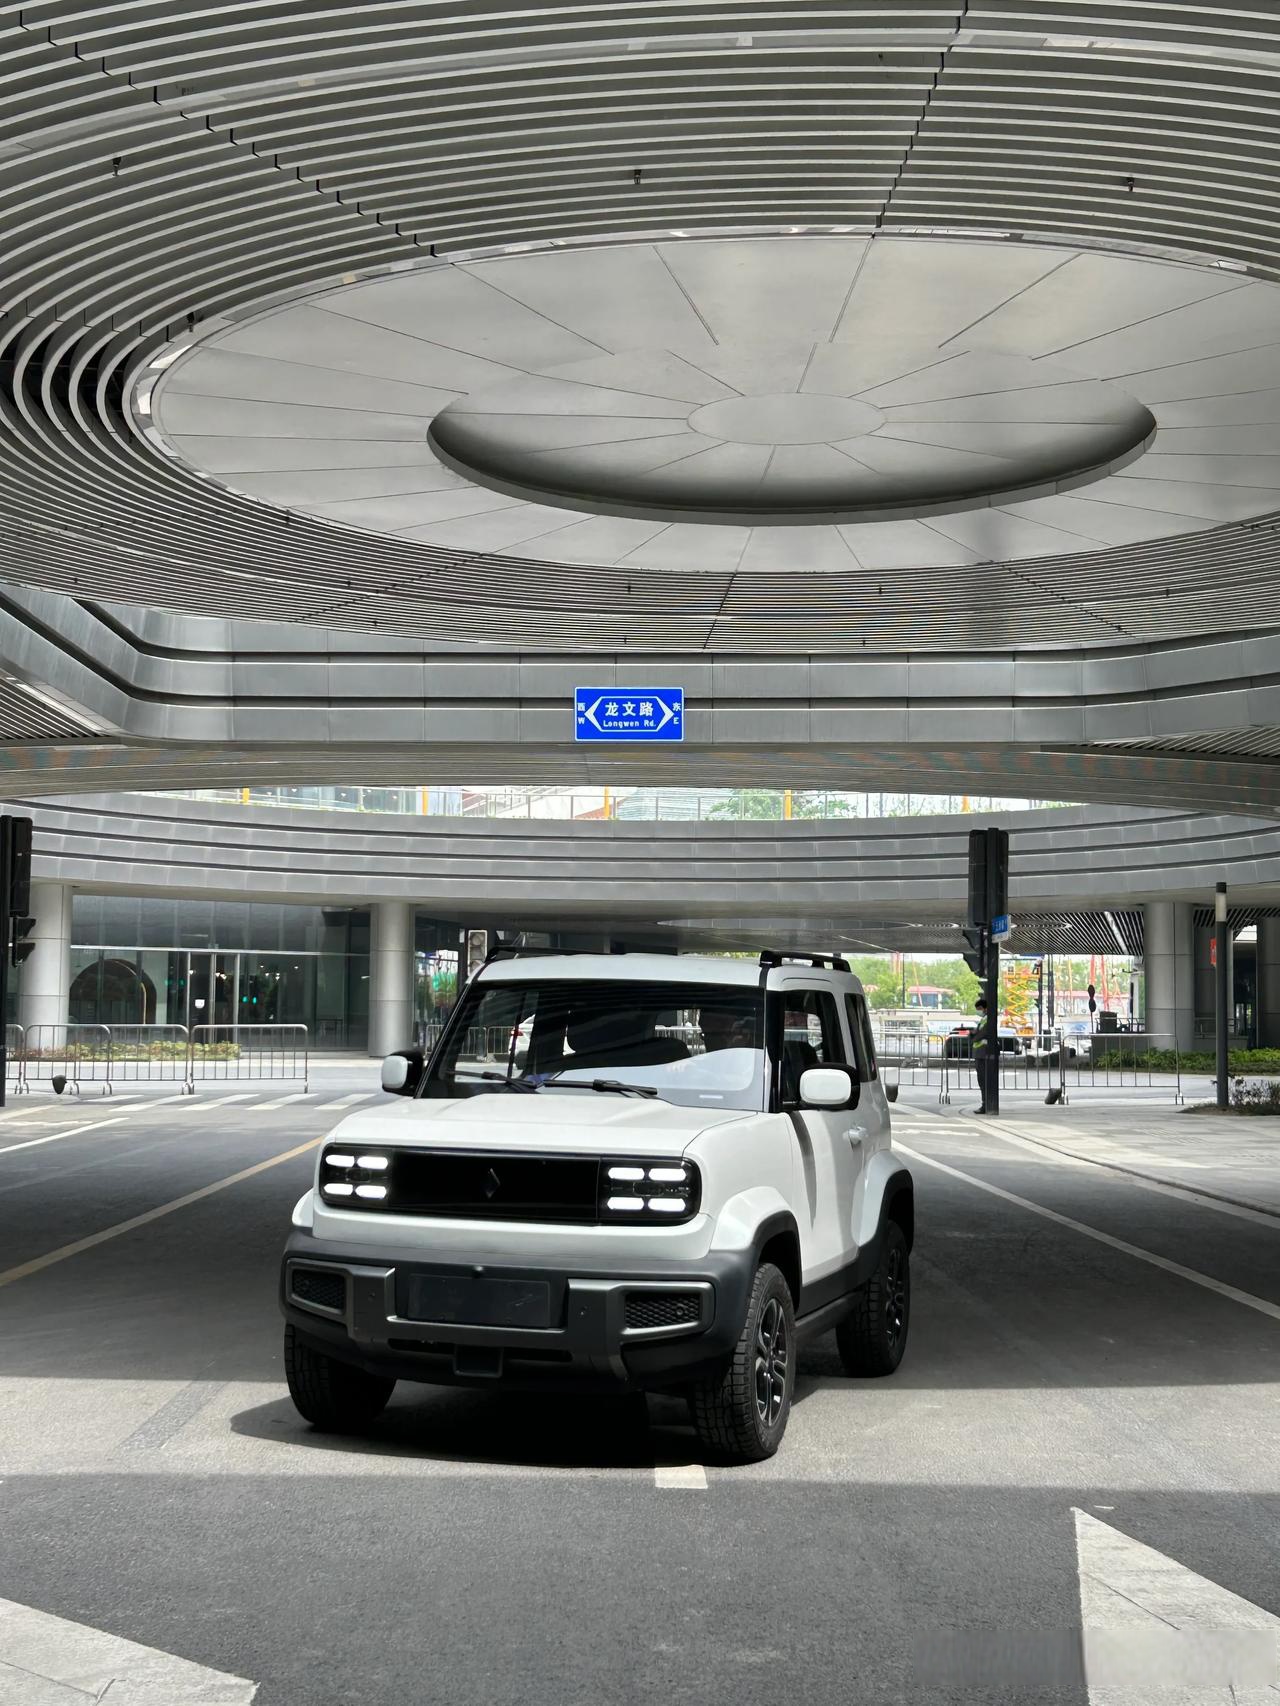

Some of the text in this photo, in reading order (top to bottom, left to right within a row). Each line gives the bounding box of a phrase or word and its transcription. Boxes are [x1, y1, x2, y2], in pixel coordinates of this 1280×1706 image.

[605, 702, 654, 716] 龙文路
[672, 702, 681, 711] 东
[603, 720, 640, 728] Longwen
